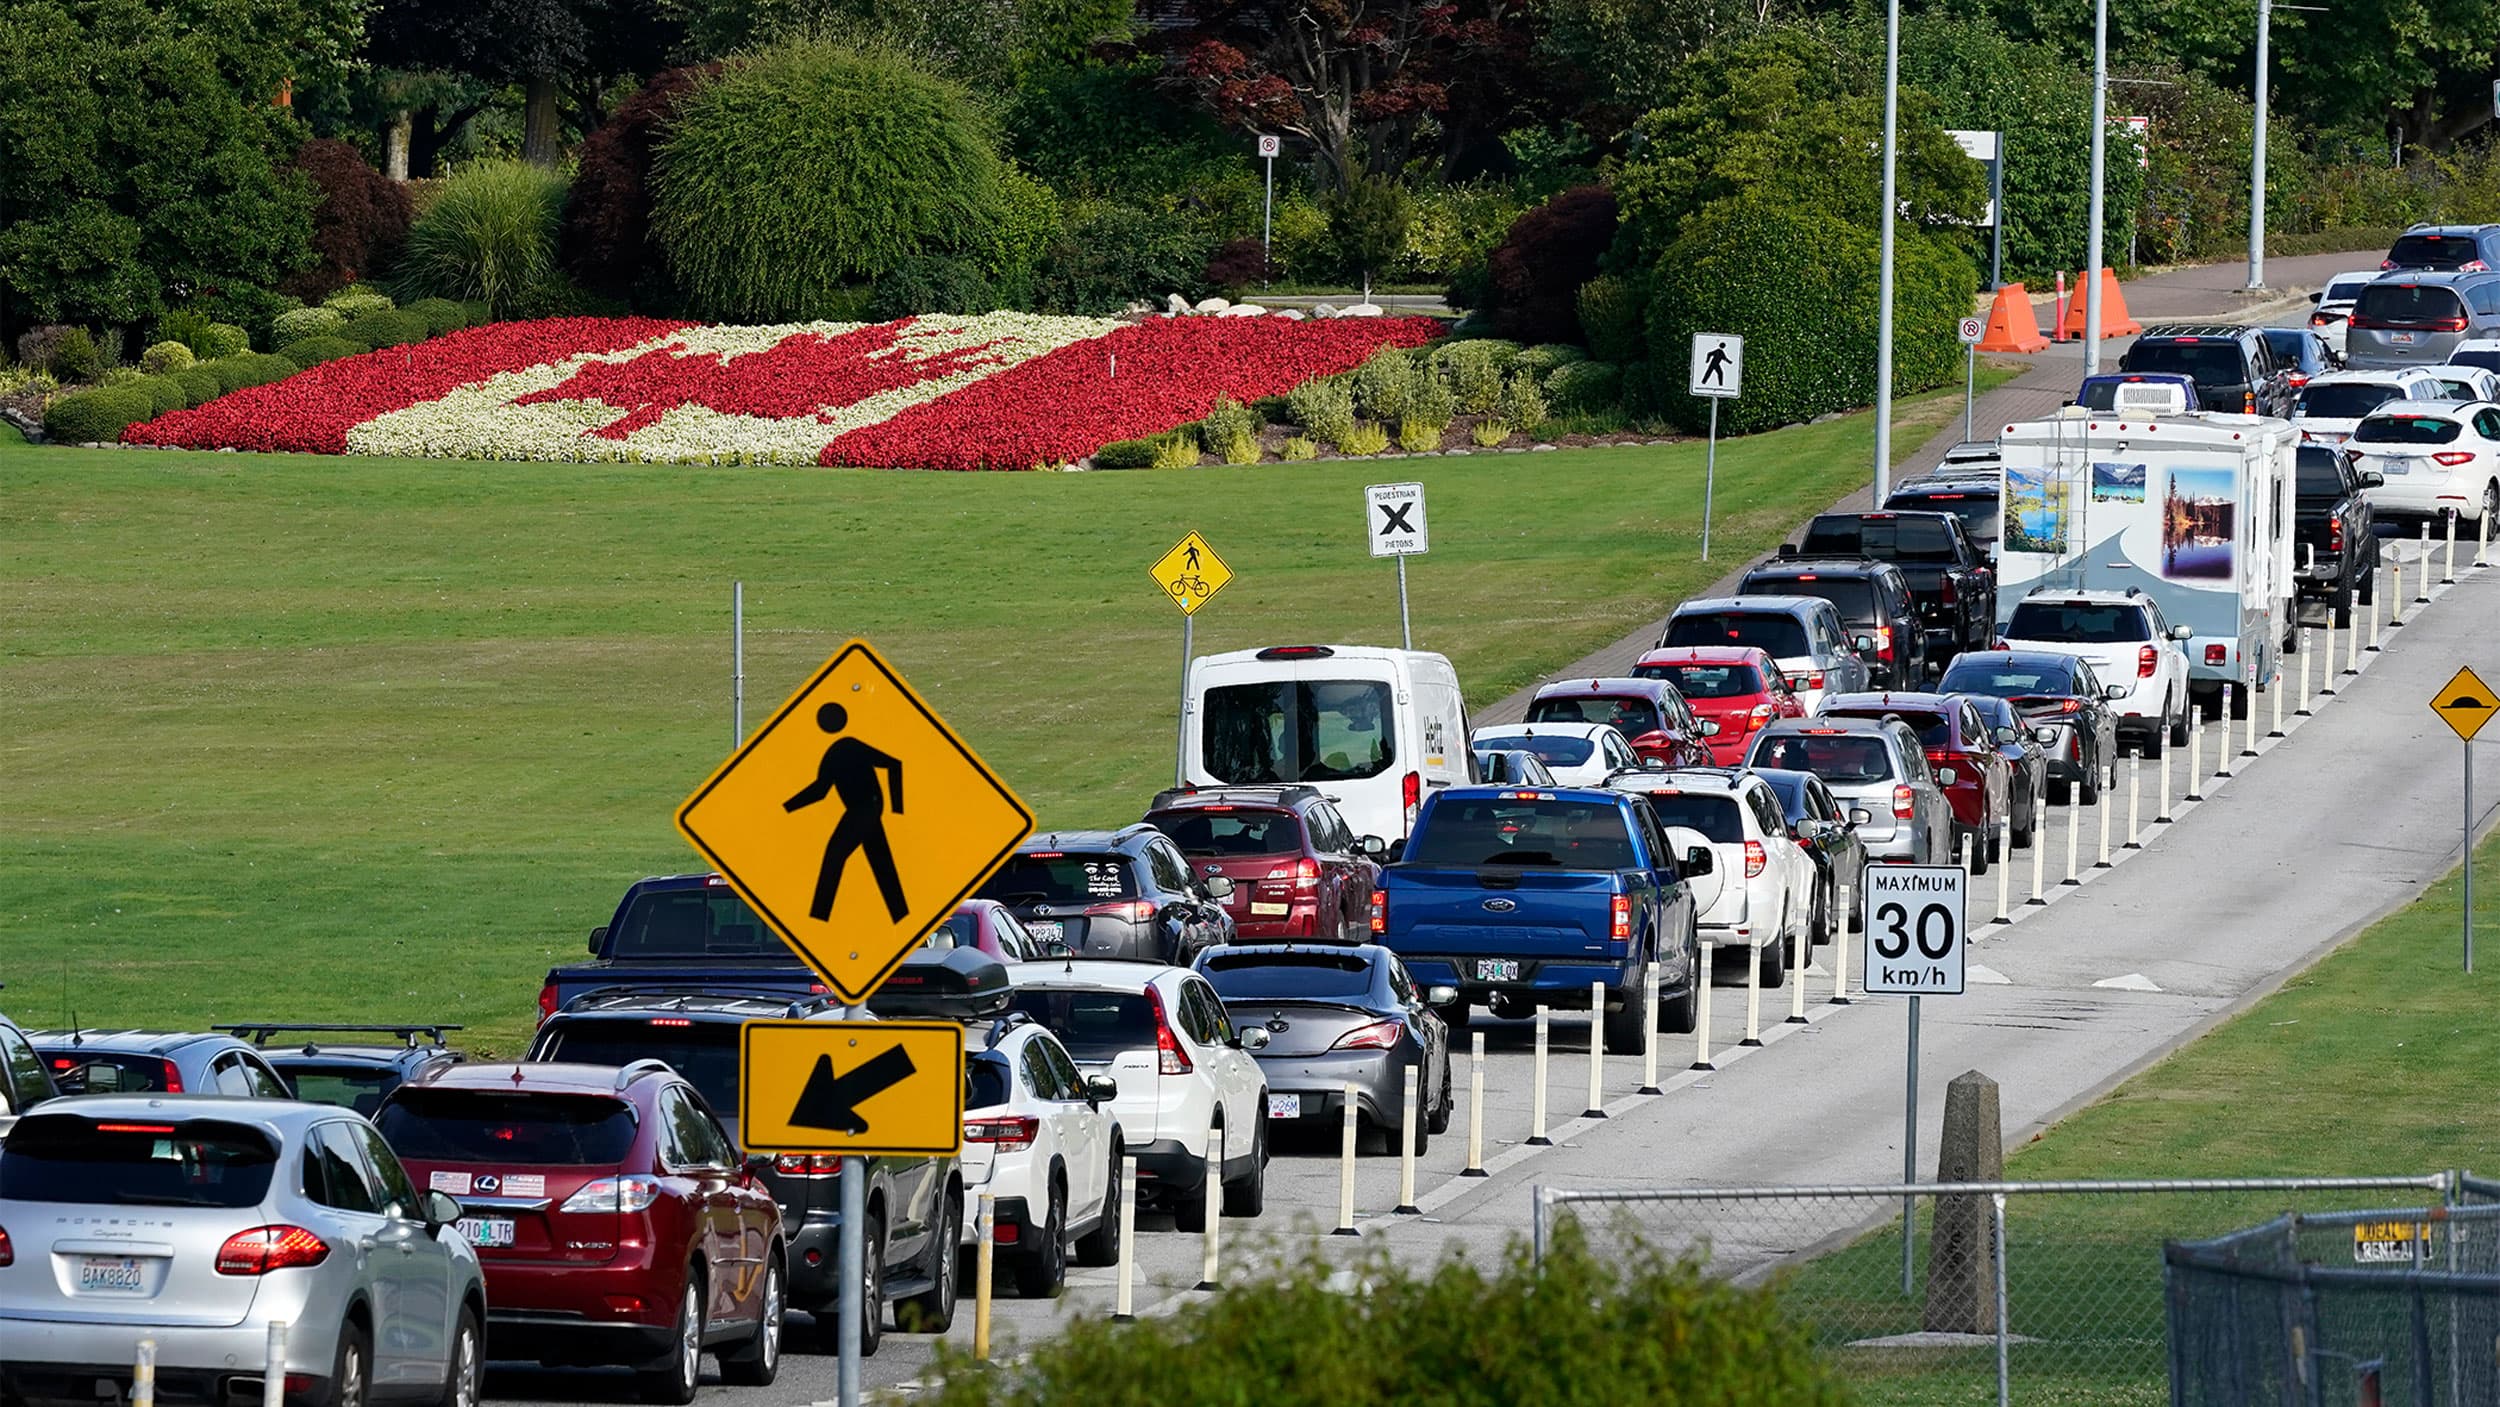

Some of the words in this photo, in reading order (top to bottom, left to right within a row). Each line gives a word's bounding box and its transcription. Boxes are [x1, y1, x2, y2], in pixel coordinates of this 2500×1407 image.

[1375, 490, 1416, 500] PEDESTRIAN
[1876, 875, 1955, 891] MAXIMUM
[1874, 902, 1955, 960] 30
[1882, 965, 1946, 985] km/h
